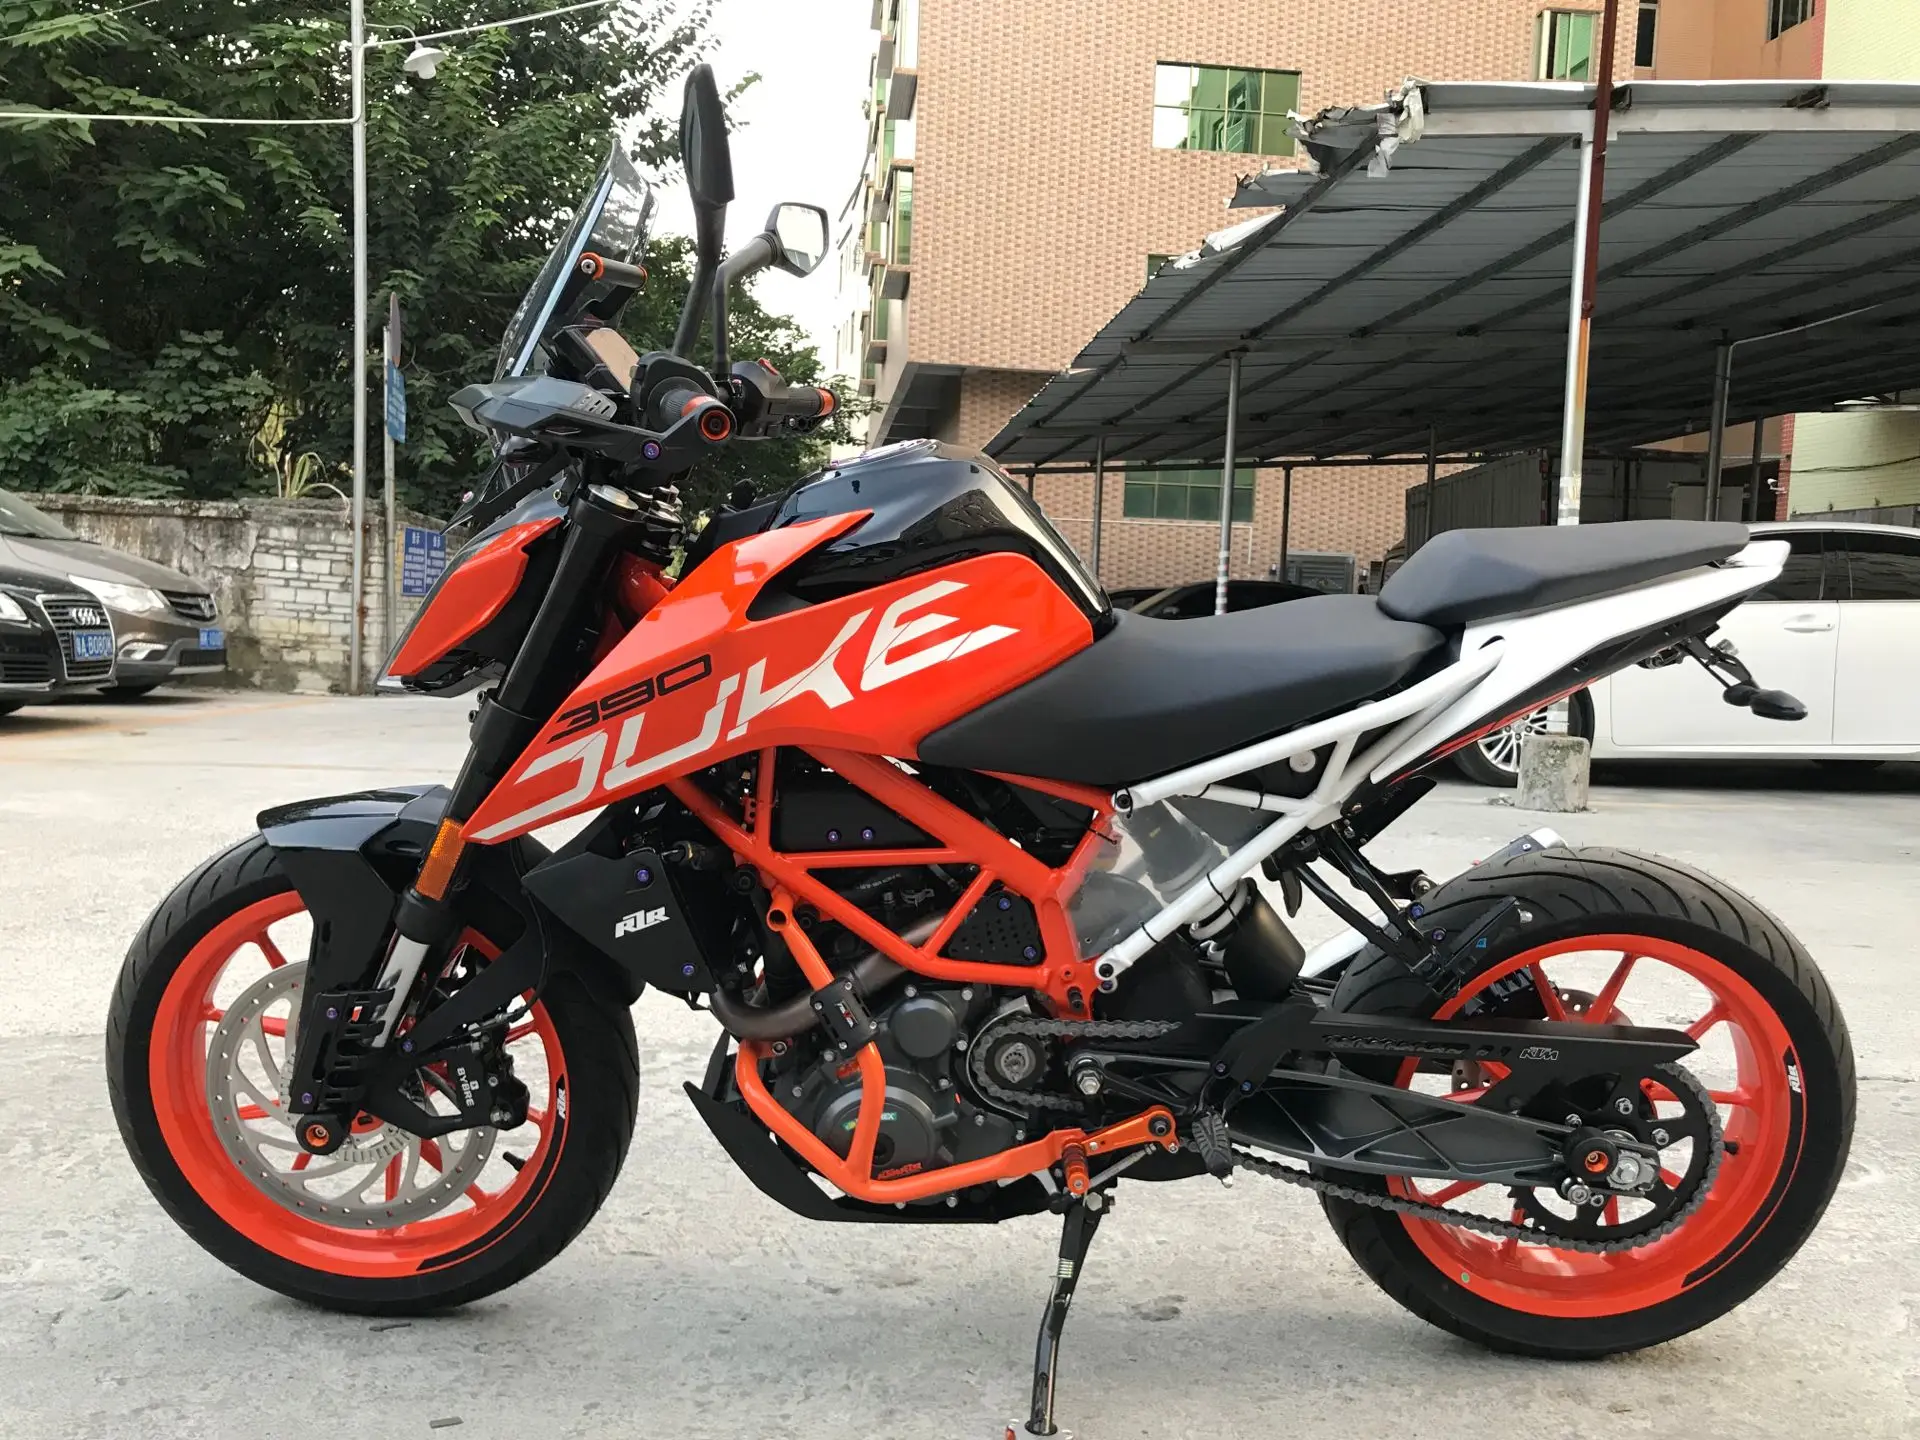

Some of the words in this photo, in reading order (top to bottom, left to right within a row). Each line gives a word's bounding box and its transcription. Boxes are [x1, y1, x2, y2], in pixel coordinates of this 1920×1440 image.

[470, 580, 1020, 839] DUKE
[547, 655, 711, 743] 390
[1519, 1046, 1559, 1060] KTM
[457, 1067, 475, 1106] BYBRE
